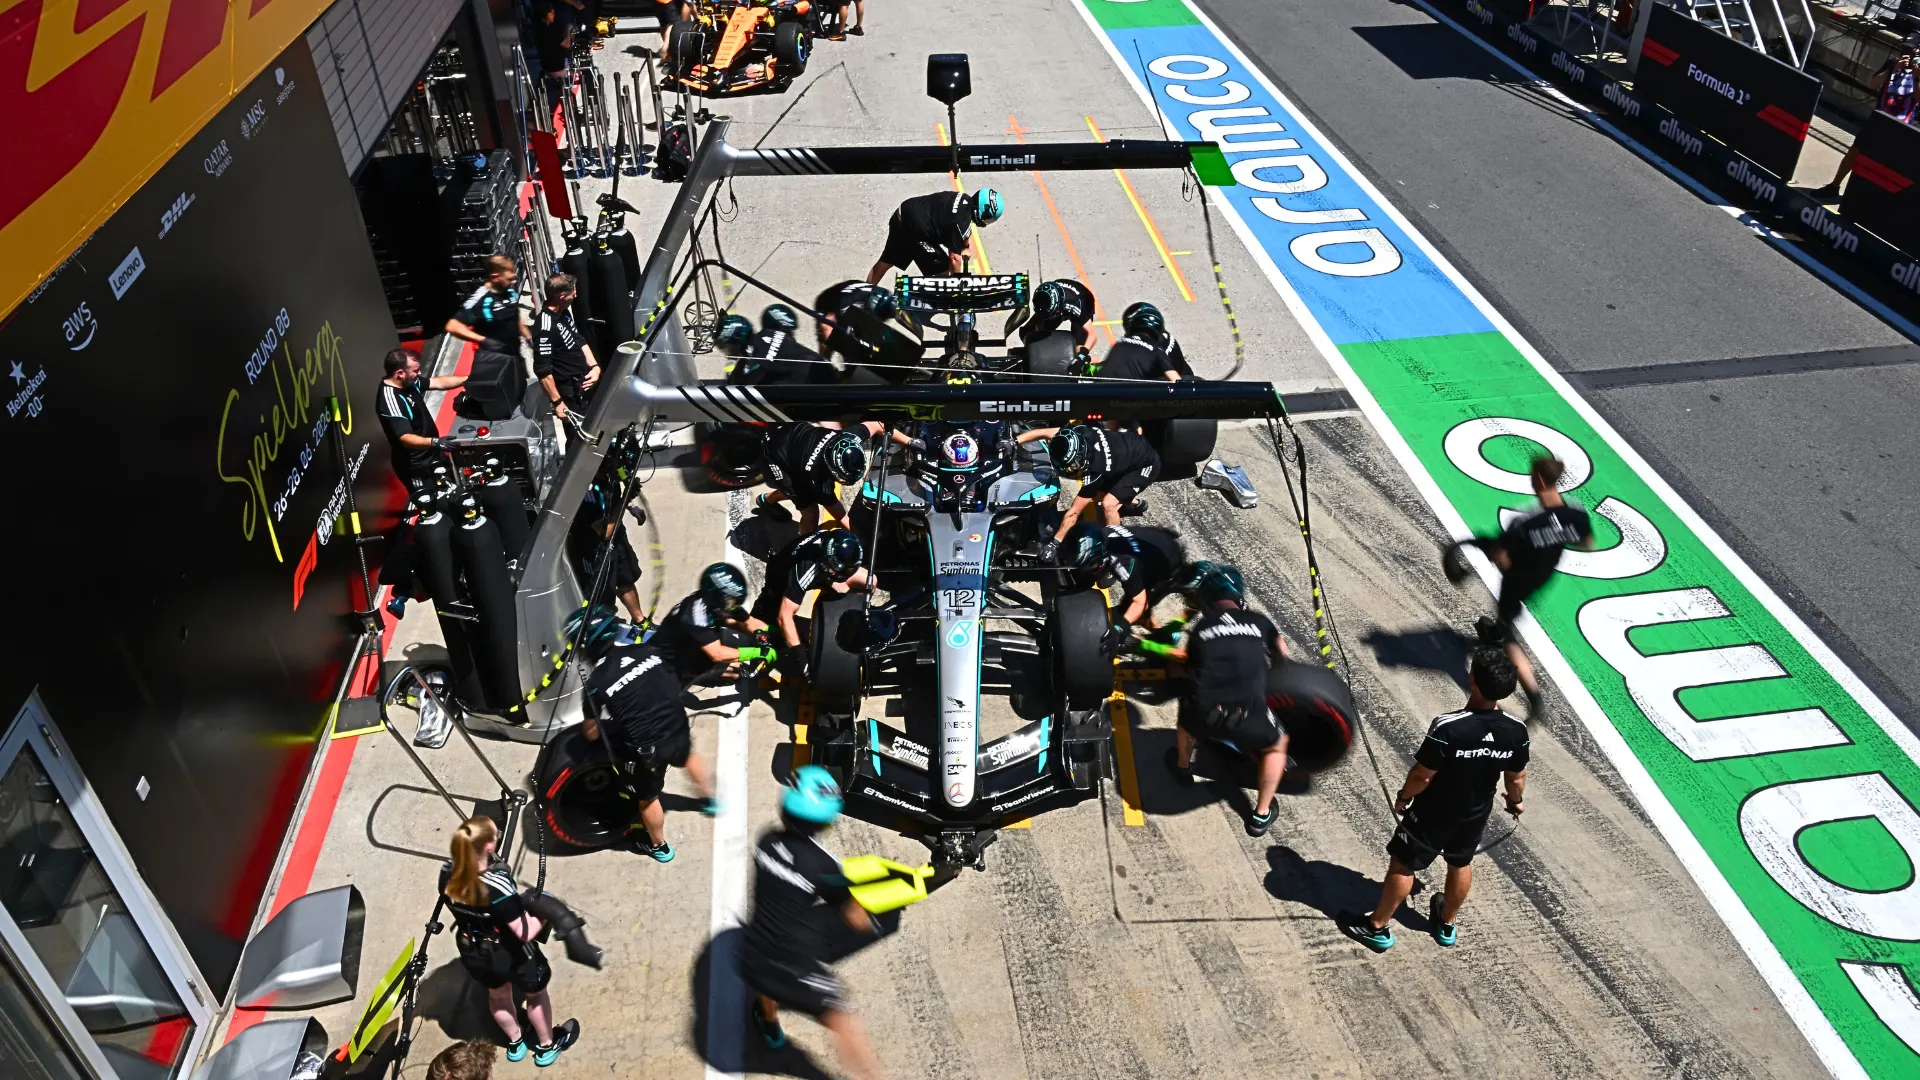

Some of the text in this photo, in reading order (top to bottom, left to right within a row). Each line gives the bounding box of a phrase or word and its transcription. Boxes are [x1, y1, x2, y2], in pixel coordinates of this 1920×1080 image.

[1507, 23, 1537, 53] allwyn
[1552, 51, 1585, 83] allwyn
[1687, 63, 1735, 100] Formula
[247, 98, 266, 128] MSC
[1603, 82, 1641, 117] allwyn
[1659, 118, 1704, 156] allwyn
[204, 139, 229, 174] QATAR
[970, 154, 1036, 165] Einhell
[1147, 54, 1403, 277] aramco
[1726, 160, 1778, 202] allwyn
[161, 192, 191, 234] DHL
[1800, 206, 1860, 253] allwyn
[113, 257, 141, 292] Lenovo
[912, 276, 1013, 292] PETRONAS
[62, 301, 91, 342] aws
[245, 307, 290, 385] ROUND 08
[6, 369, 47, 418] Heineken
[980, 400, 1071, 413] Einhell
[217, 320, 352, 562] Spielberg
[940, 567, 980, 576] Syntium
[943, 588, 975, 608] 12
[888, 742, 929, 767] Syntium
[1455, 747, 1514, 759] PETRONAS
[874, 790, 927, 813] TeamViewer
[1002, 785, 1055, 810] TeamViewer
